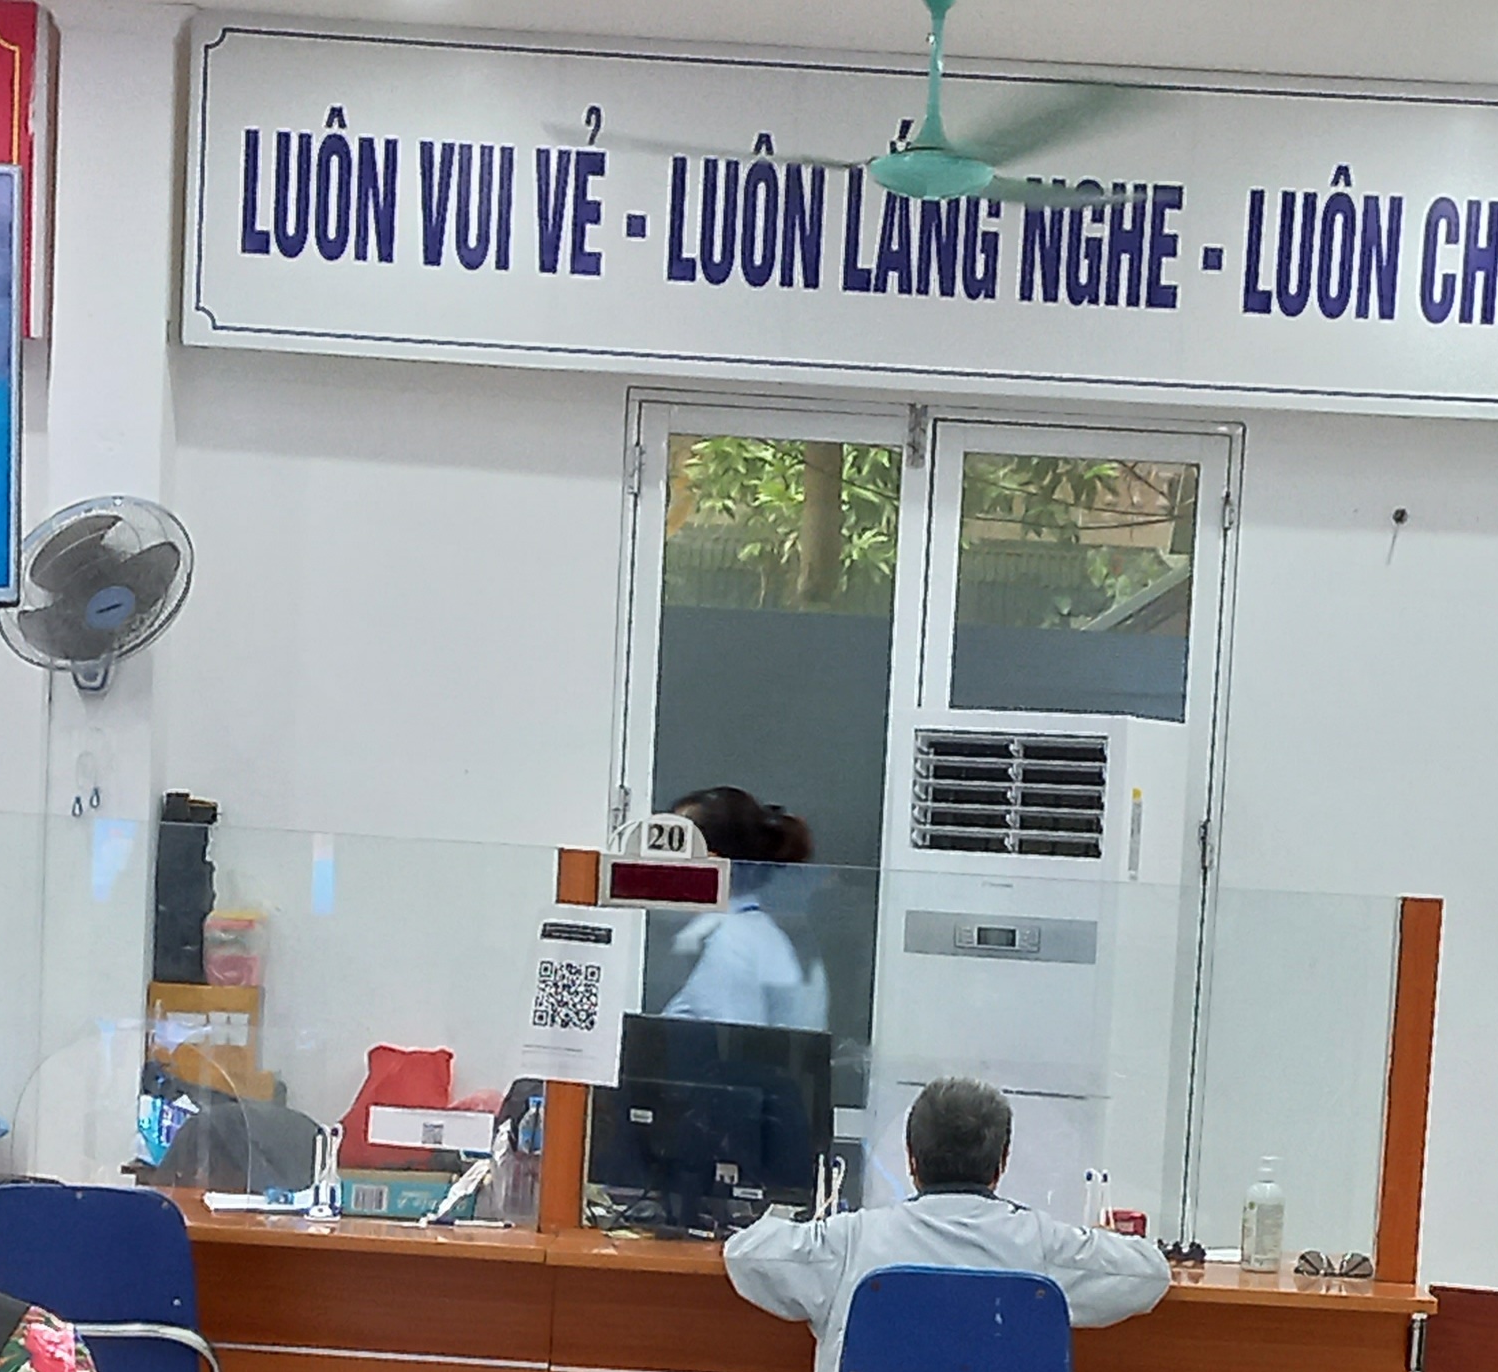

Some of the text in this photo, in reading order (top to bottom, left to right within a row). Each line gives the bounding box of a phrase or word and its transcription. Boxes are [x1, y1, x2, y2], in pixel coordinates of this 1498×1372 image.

[240, 106, 399, 263] LUÔN
[419, 139, 515, 272] VUI
[534, 105, 607, 275] VẺ
[667, 132, 826, 289] LUÔN
[1019, 177, 1184, 309] NGHE
[1243, 165, 1402, 320] LUÔN
[648, 823, 685, 853] 20
